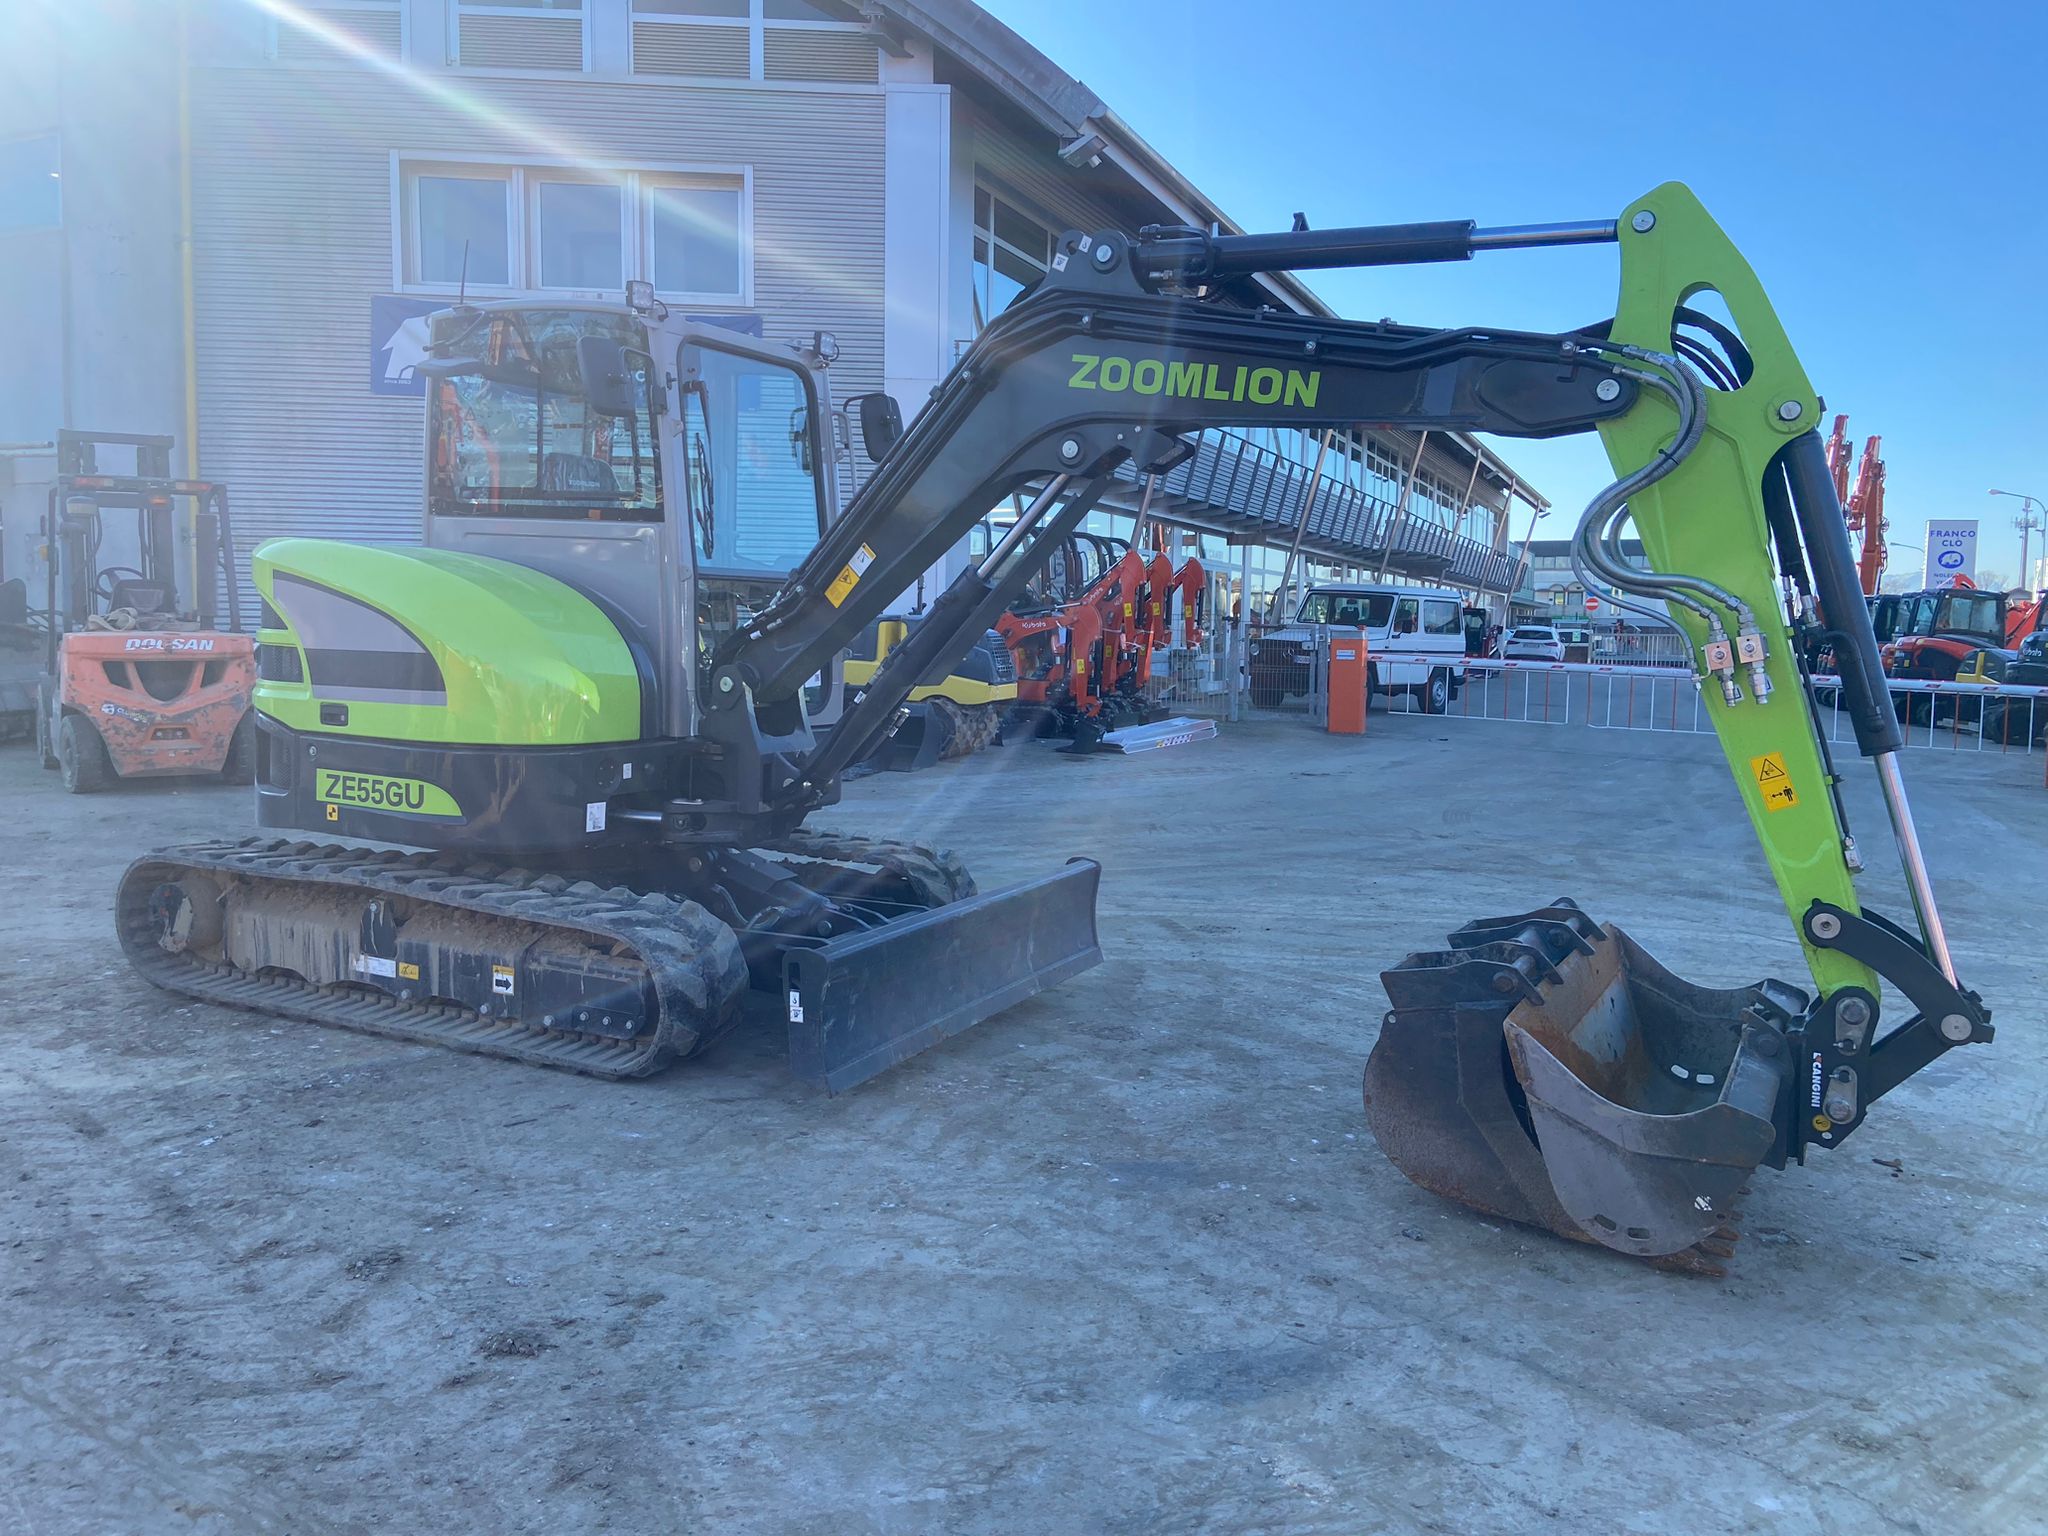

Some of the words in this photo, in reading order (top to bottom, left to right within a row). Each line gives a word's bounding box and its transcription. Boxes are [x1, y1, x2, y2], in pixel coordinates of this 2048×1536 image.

[1068, 354, 1321, 408] ZOOMLION
[1930, 530, 1976, 538] FRANCO
[1021, 620, 1047, 629] Kubota
[325, 773, 425, 809] ZE55GU
[1810, 1061, 1822, 1108] CANGINI
